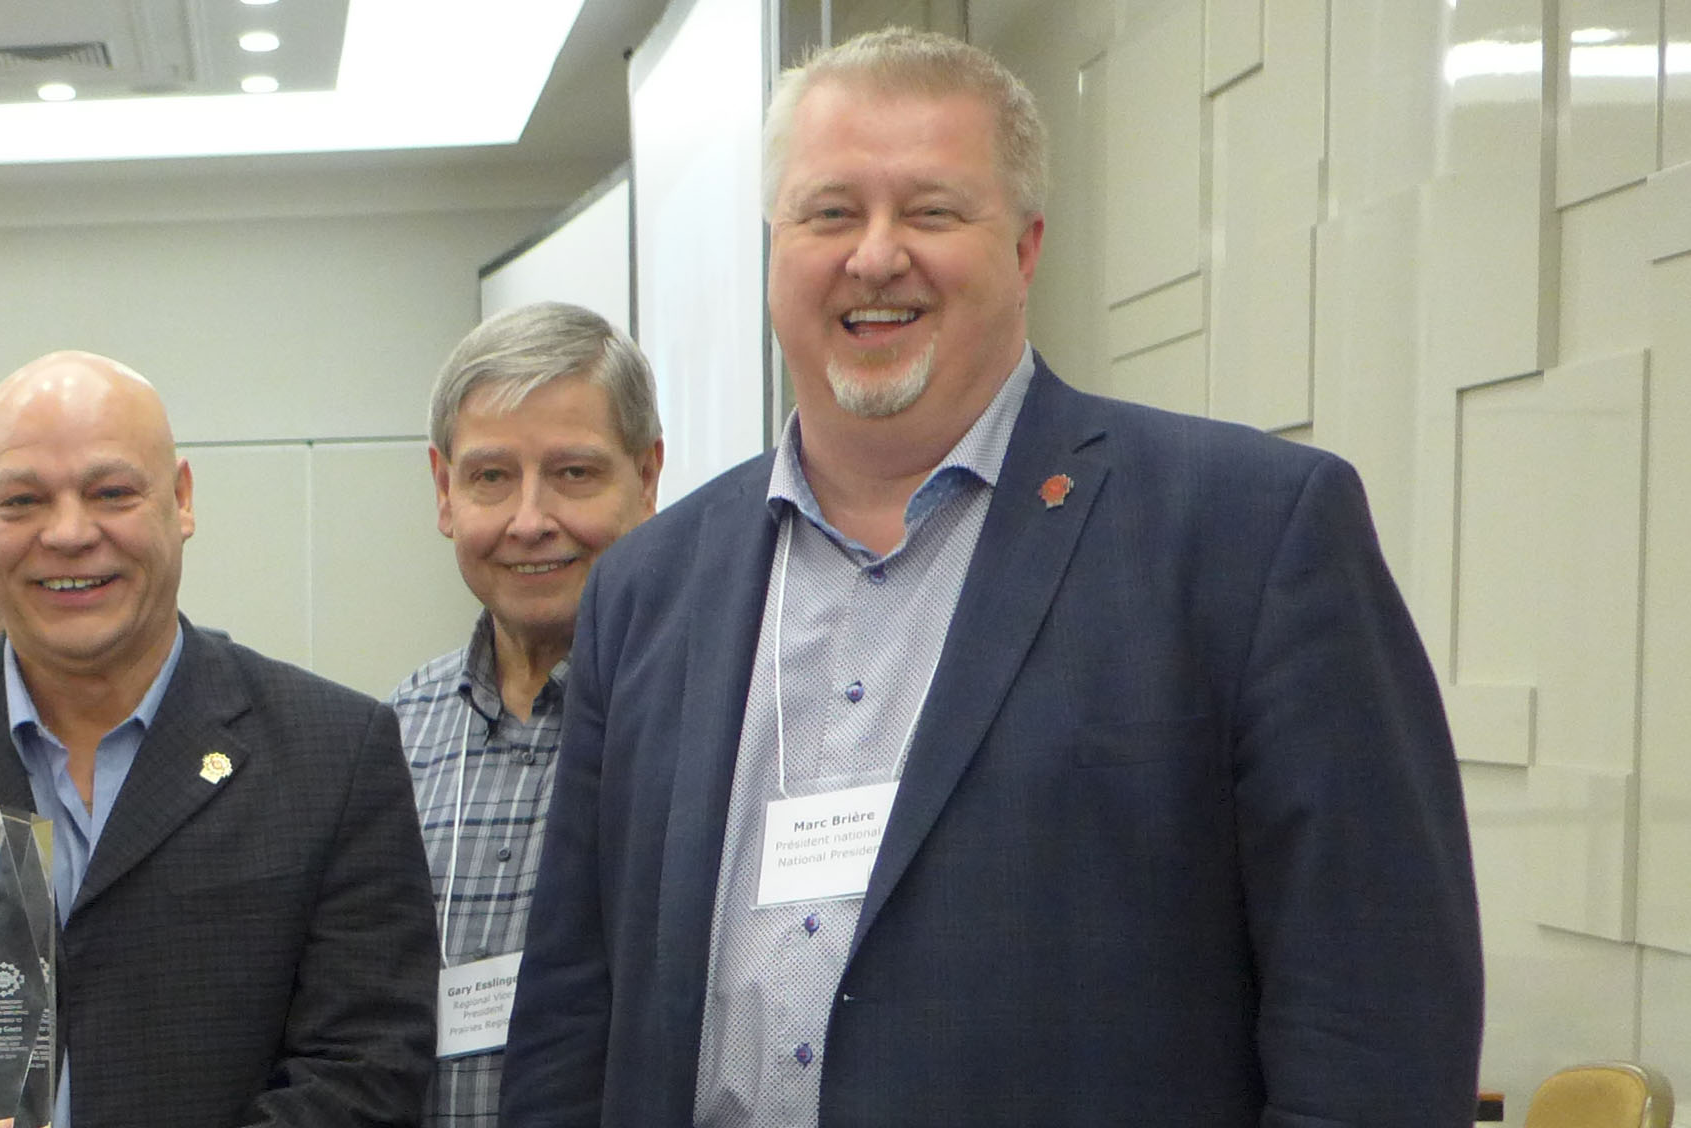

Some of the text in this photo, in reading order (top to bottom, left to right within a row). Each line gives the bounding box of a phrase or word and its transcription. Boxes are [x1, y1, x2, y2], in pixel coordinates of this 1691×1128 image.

[794, 811, 875, 833] Marc Brière
[775, 827, 881, 851] Président national
[778, 852, 826, 868] National
[447, 984, 473, 997] Gary
